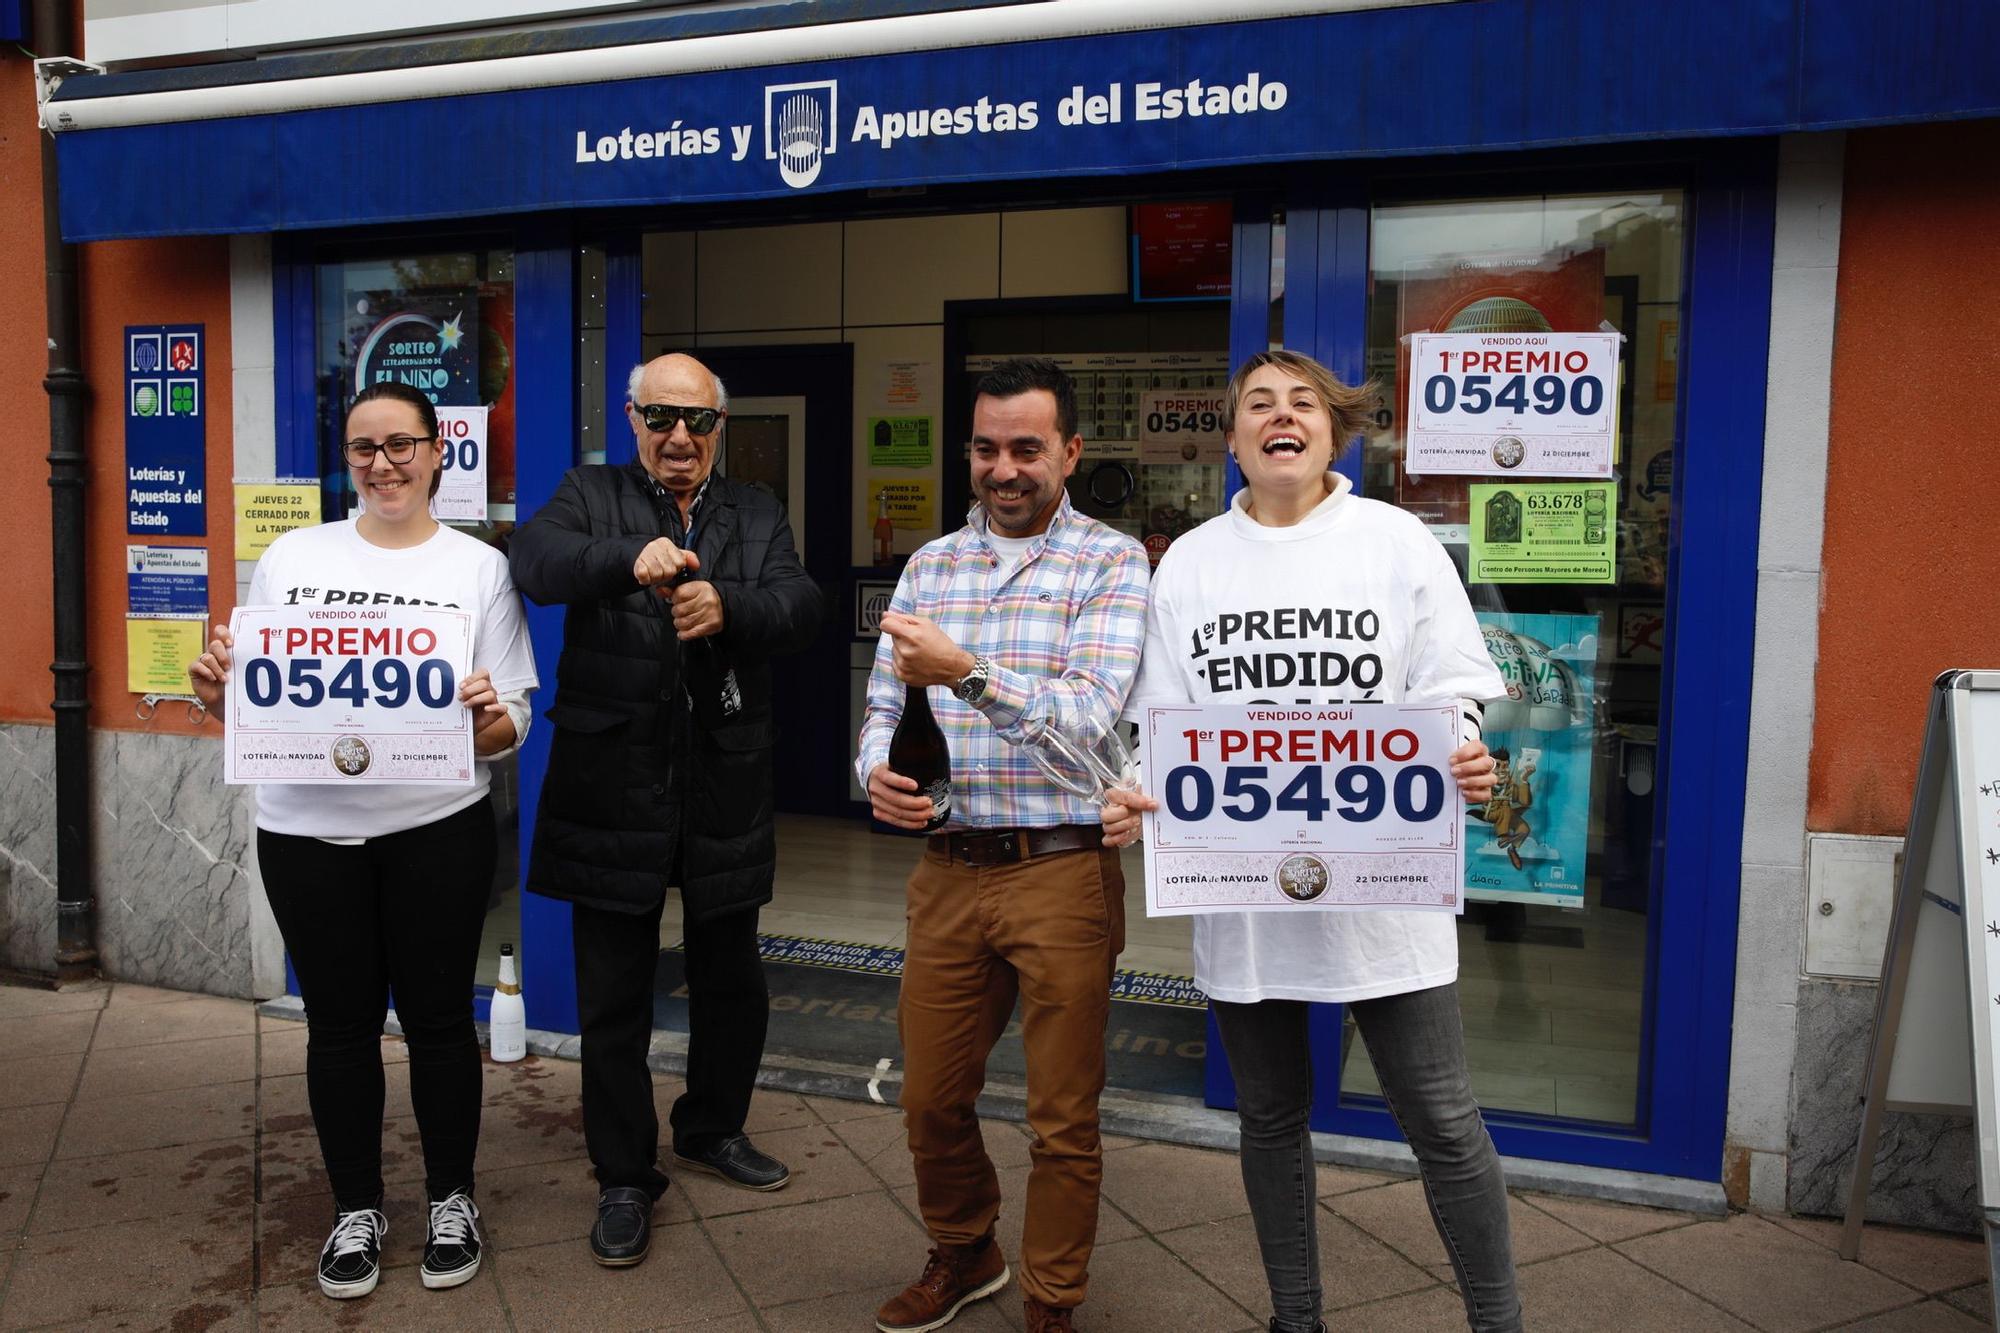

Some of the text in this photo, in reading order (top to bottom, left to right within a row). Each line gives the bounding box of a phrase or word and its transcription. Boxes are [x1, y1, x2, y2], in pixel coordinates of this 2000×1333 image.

[576, 72, 1288, 163] Loterías y Apuestas del Estado
[388, 342, 436, 355] SORTEO
[1481, 336, 1548, 346] VENDIDO AQUÍ
[1462, 351, 1589, 374] PREMIO
[401, 369, 449, 389] NIÑO
[1424, 375, 1604, 416] 05490
[1147, 412, 1225, 433] 0549
[1420, 447, 1447, 455] LOTERÍA
[130, 467, 185, 485] Loterías y
[130, 489, 202, 505] Apuestas del
[253, 496, 302, 505] JUEVES 22
[1528, 495, 1584, 509] 63.678
[131, 511, 169, 526] Estado
[245, 510, 310, 519] CERRADO POR
[256, 525, 267, 533] LA
[284, 587, 320, 605] 1er
[308, 609, 388, 620] VENDIDO AQUÍ
[1190, 608, 1380, 659] 1er PREMIO
[259, 628, 437, 656] 1er PREMIO
[245, 658, 456, 709] 05490
[1247, 709, 1353, 721] VENDIDO AQUÍ
[1183, 728, 1420, 762] 1er PREMIO
[243, 751, 278, 760] LOTERÍA
[1165, 765, 1445, 822] 05490
[1166, 873, 1207, 884] LOTERÍA
[1221, 874, 1269, 883] NAVIDAD
[1356, 875, 1368, 883] 22
[1371, 875, 1429, 883] DICIEMBRE
[795, 942, 825, 951] POR
[767, 947, 785, 956] LA
[788, 950, 862, 965] DISTANCIA
[867, 958, 886, 967] DE
[1132, 976, 1162, 987] POR
[1130, 986, 1208, 1001] DISTANCI
